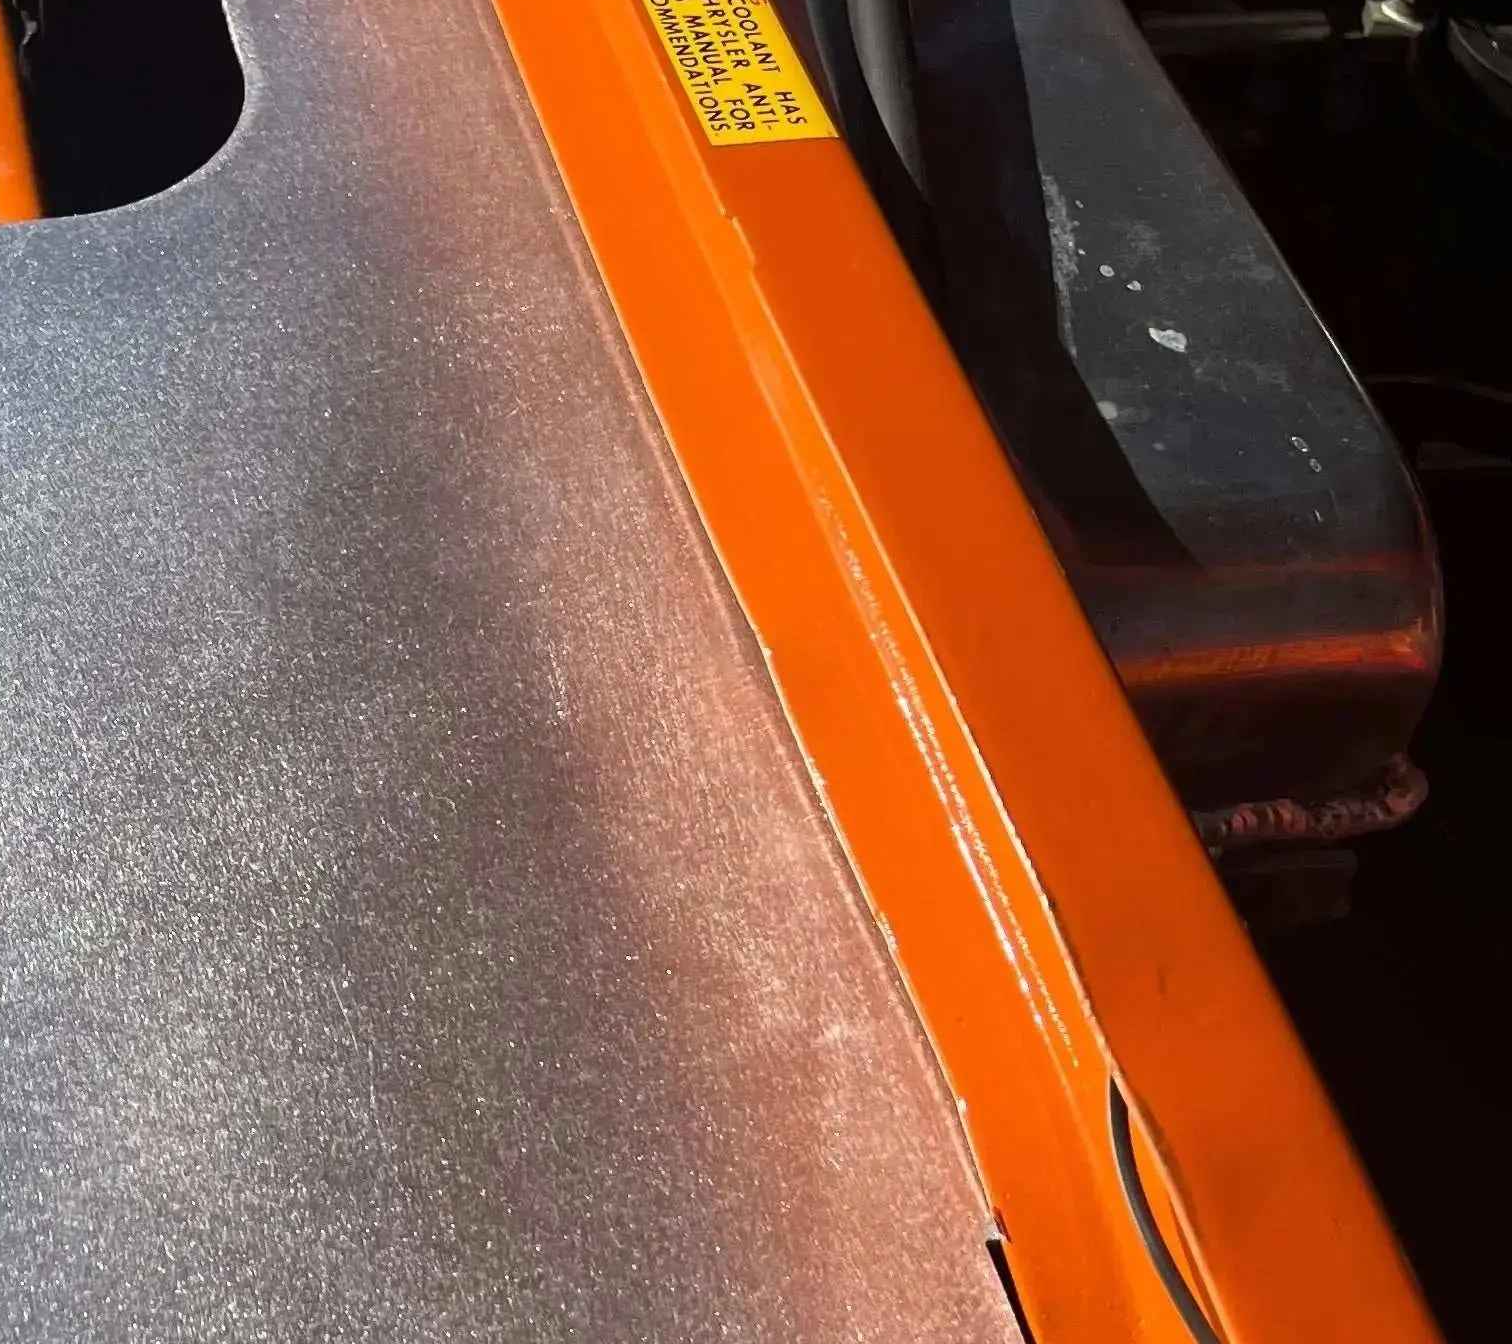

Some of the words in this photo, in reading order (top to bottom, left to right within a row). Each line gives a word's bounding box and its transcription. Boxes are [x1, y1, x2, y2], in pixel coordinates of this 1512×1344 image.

[683, 15, 732, 85] MANUAL
[725, 99, 755, 131] FOR
[743, 83, 779, 131] ANTI-
[774, 91, 807, 125] HAS
